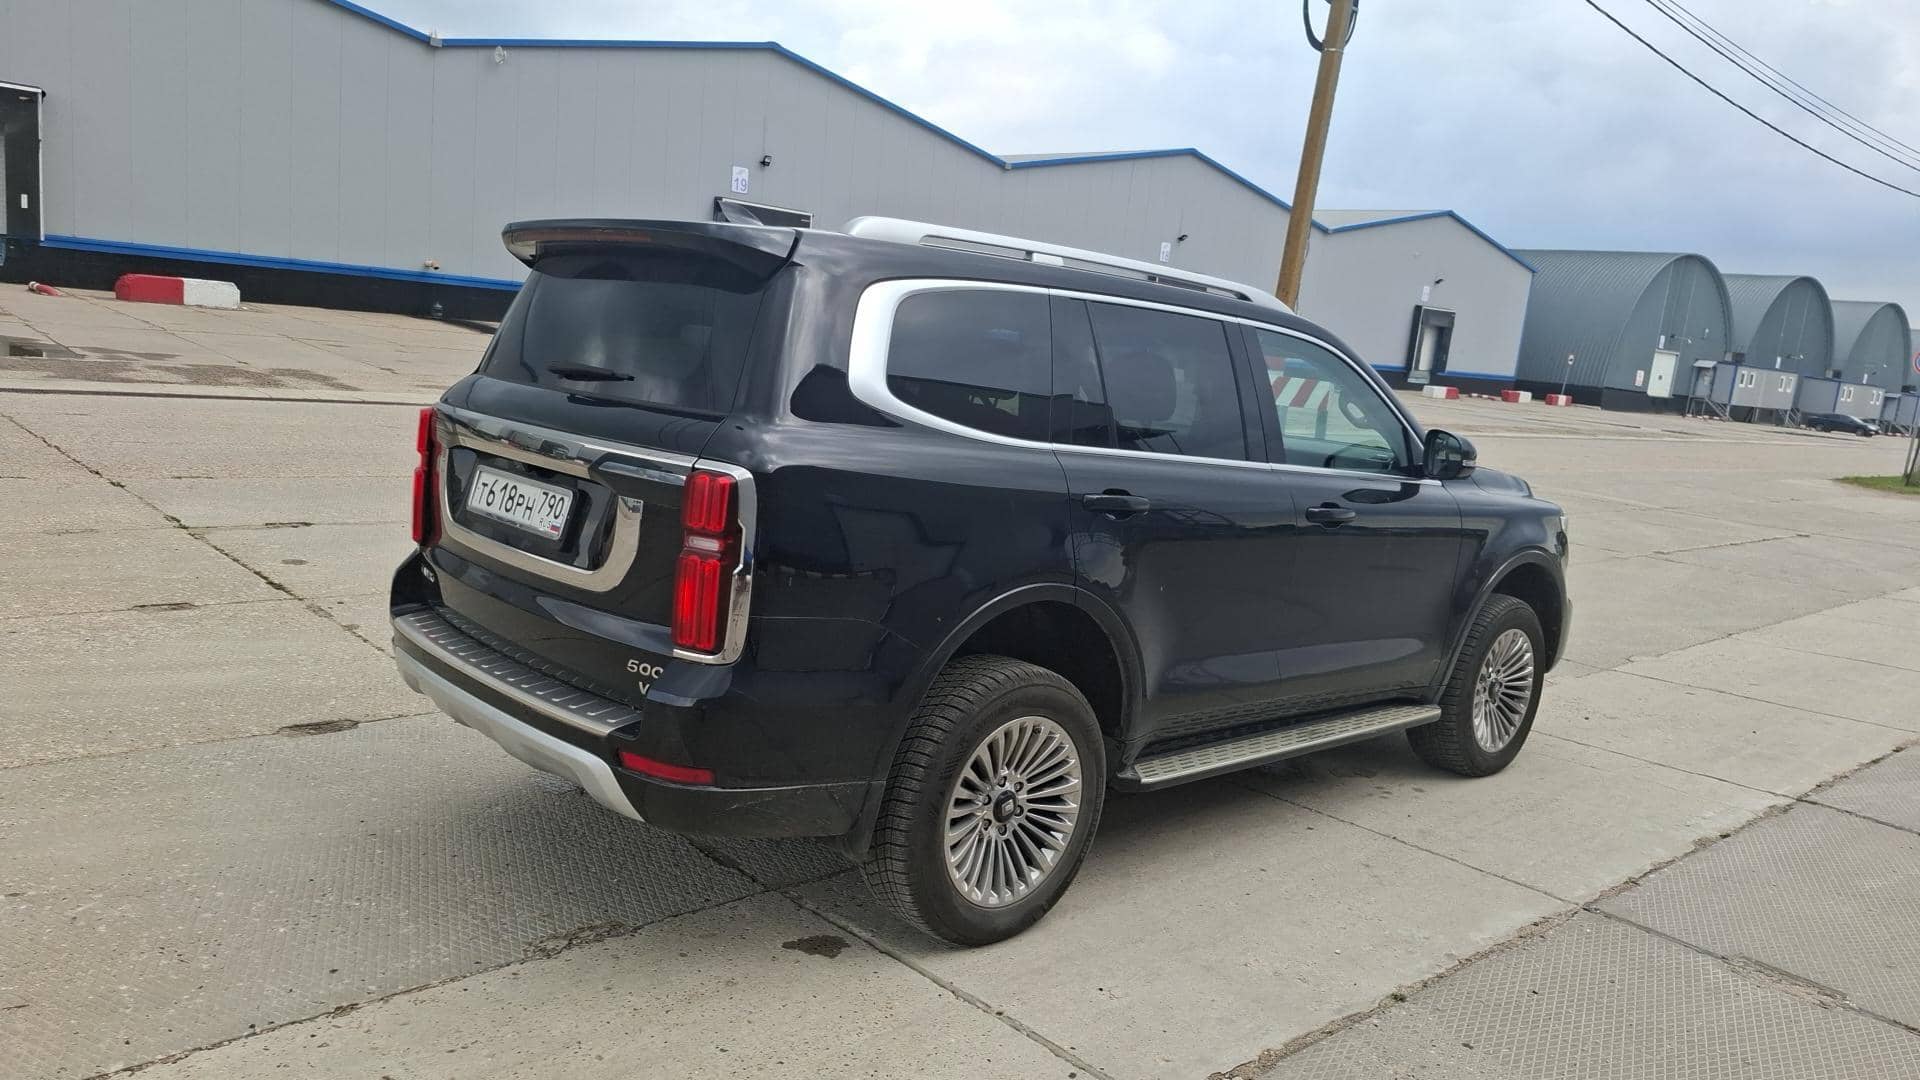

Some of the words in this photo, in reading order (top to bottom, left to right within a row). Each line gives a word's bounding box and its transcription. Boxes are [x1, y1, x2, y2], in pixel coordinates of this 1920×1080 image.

[734, 177, 747, 192] 19
[479, 479, 536, 521] Т618РН
[538, 491, 565, 520] 790
